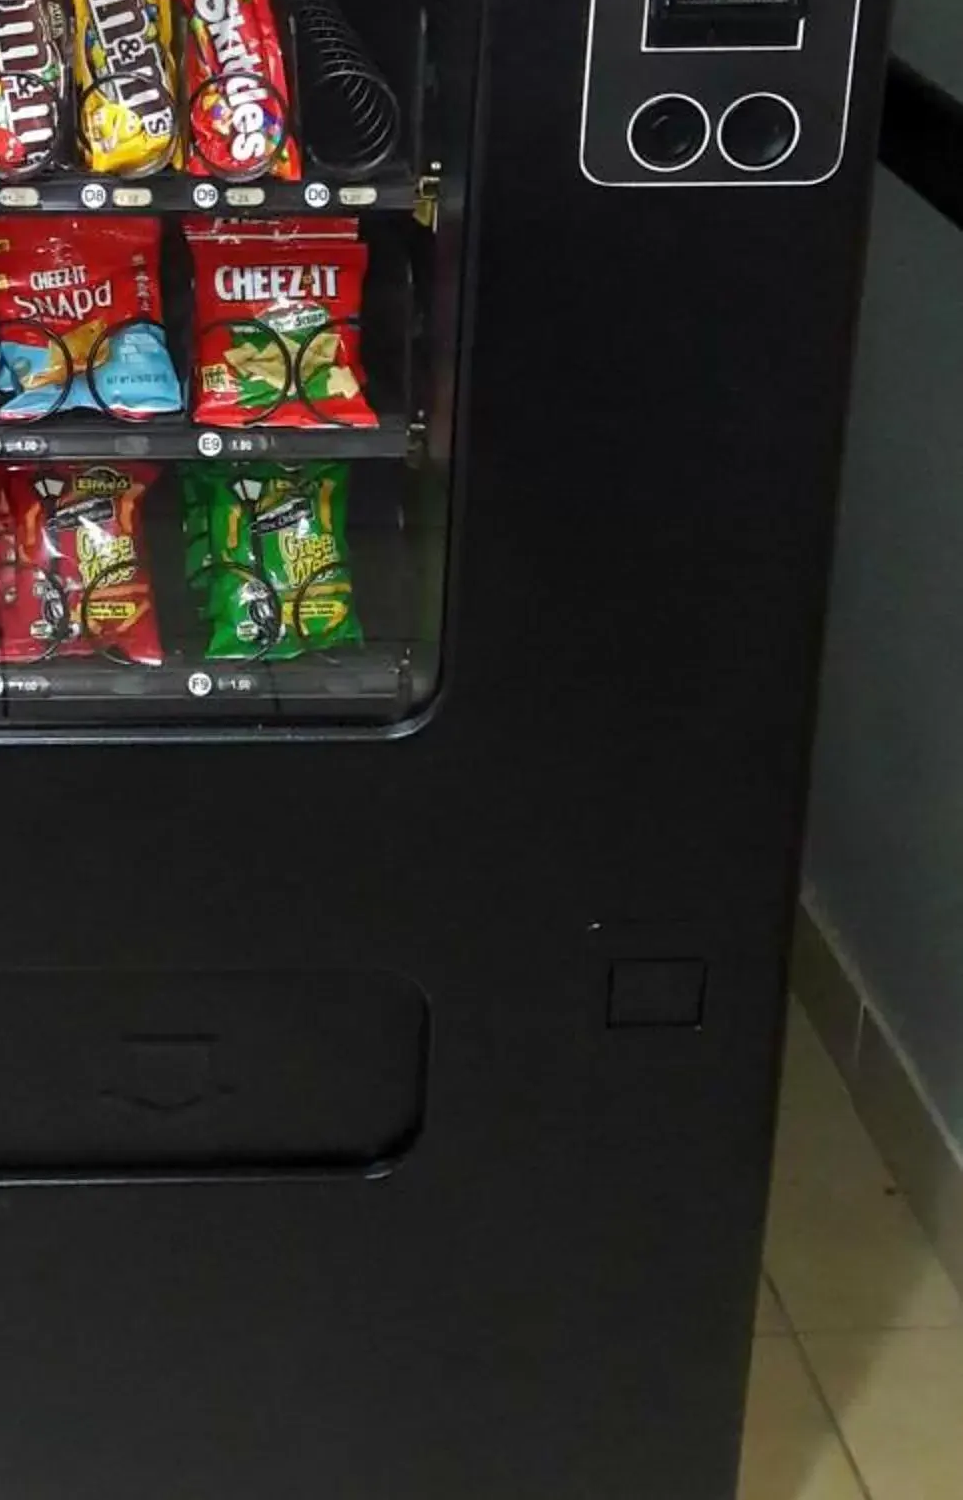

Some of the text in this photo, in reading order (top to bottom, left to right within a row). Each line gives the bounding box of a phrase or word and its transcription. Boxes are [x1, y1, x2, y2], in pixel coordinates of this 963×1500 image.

[84, 186, 106, 202] D8
[196, 186, 216, 201] D9
[202, 436, 221, 450] E9
